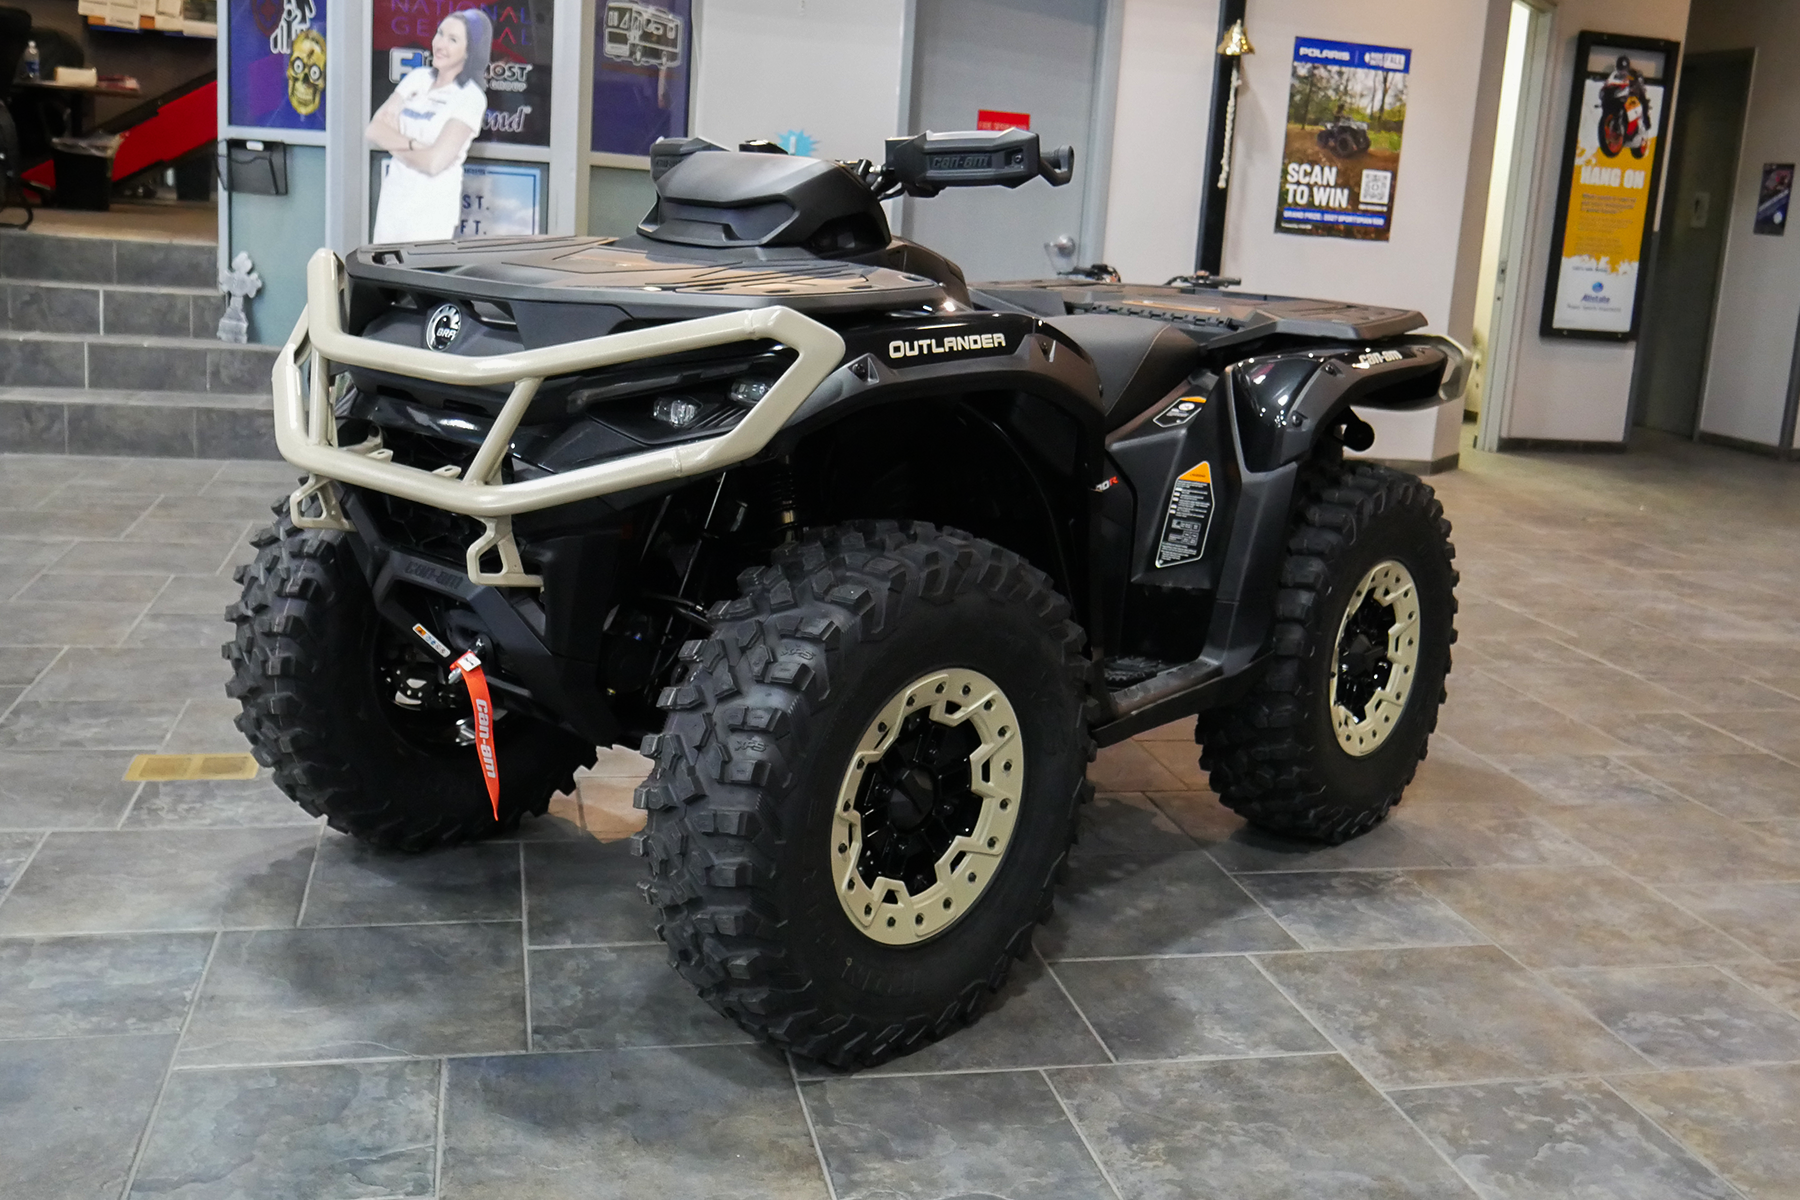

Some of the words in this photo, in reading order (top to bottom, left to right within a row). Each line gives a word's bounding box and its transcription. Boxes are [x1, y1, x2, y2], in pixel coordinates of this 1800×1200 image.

[391, 16, 532, 46] GEAL
[1287, 162, 1337, 187] SCAN
[1580, 165, 1621, 187] HANG
[1623, 168, 1645, 189] ON
[1285, 183, 1310, 205] TO
[1312, 185, 1350, 209] WIN
[889, 333, 1006, 359] OUTLANDER
[475, 698, 497, 779] can-am
